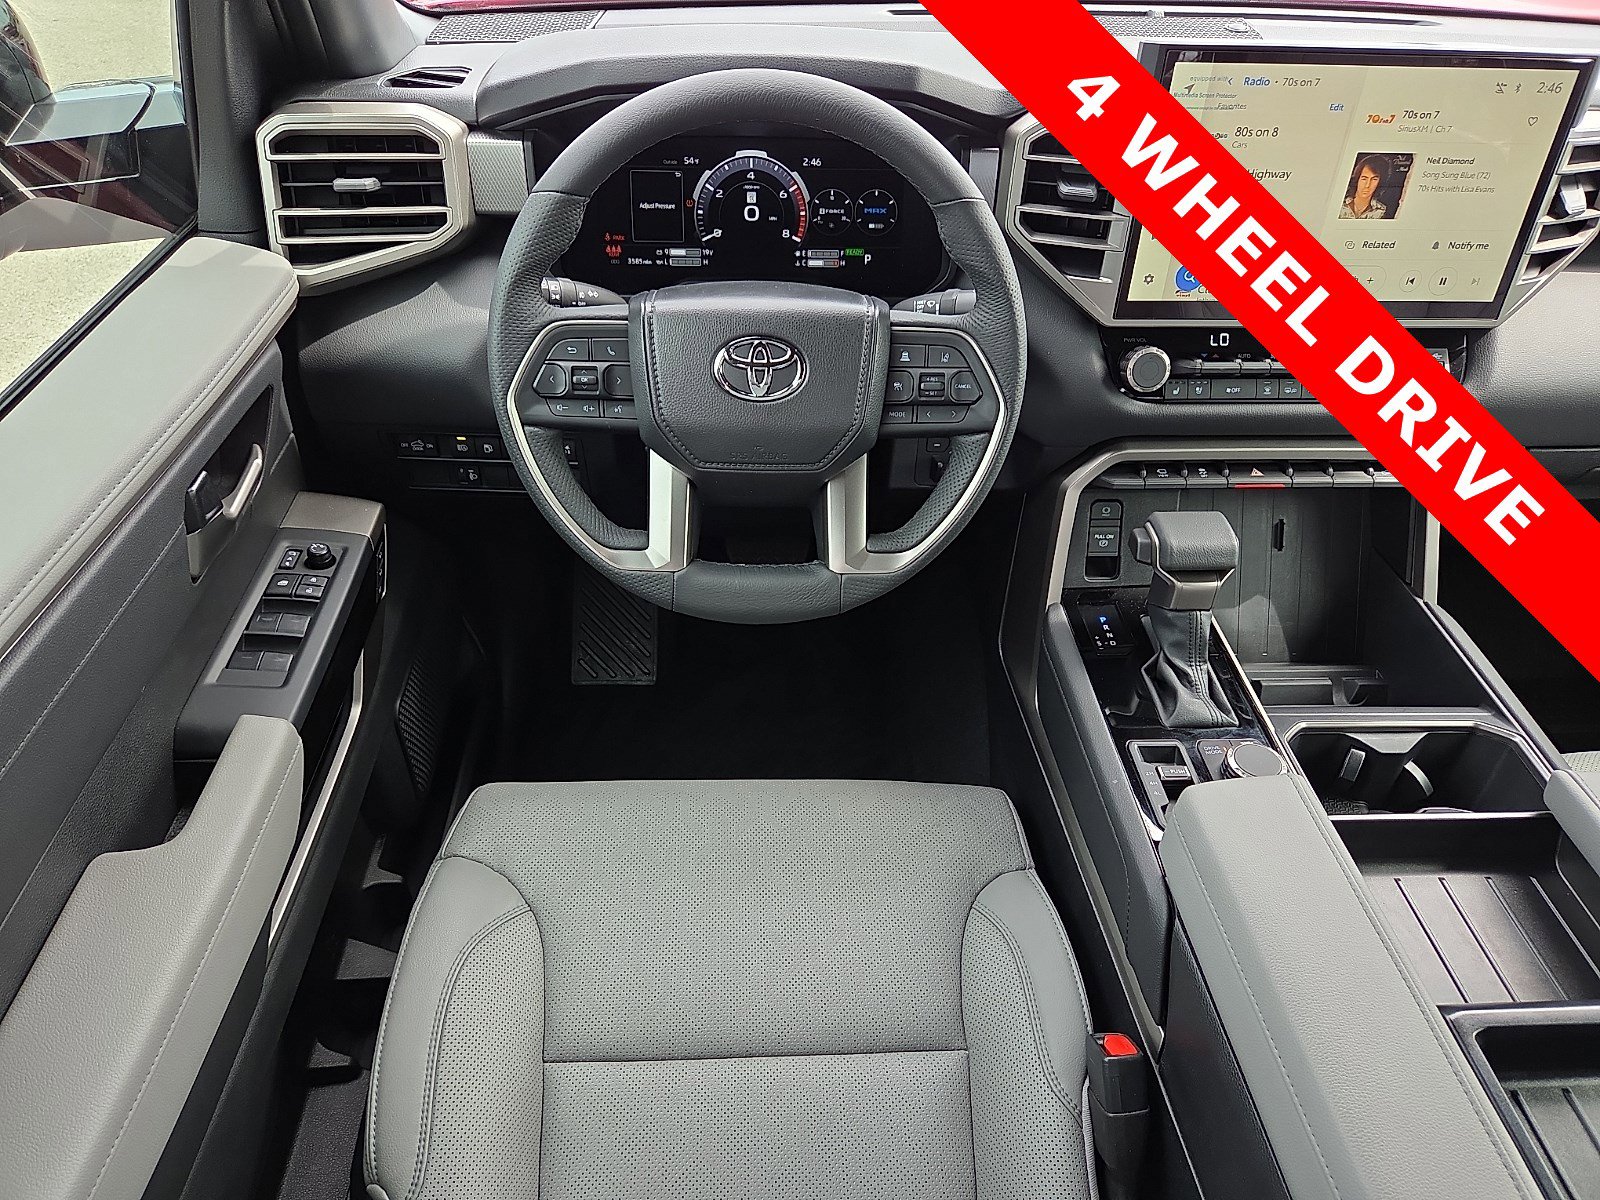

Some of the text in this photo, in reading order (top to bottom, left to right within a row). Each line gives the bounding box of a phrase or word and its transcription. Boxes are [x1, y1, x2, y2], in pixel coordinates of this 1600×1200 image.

[1243, 77, 1270, 87] Radio
[1282, 78, 1299, 87] 70s
[1313, 78, 1321, 87] 7
[1536, 81, 1563, 94] 2:46
[1217, 102, 1248, 110] Favorites
[1329, 103, 1344, 112] Edit
[1402, 110, 1418, 119] 70s
[1433, 110, 1441, 120] 7
[1234, 126, 1253, 138] 80s
[1255, 128, 1270, 138] on
[1271, 126, 1279, 138] 8
[1397, 125, 1429, 133] SiriusXM
[1435, 125, 1446, 133] Ch
[1231, 140, 1248, 149] Cars
[802, 157, 822, 167] 2:46
[1426, 156, 1475, 165] Neil Diamond
[746, 171, 755, 180] 4
[1422, 170, 1491, 180] Song Sung Blue (72)
[1418, 184, 1430, 192] 70s
[1430, 184, 1445, 192] Hits
[1445, 185, 1460, 193] with
[1460, 185, 1475, 193] Lisa
[715, 189, 724, 198] 2
[779, 190, 788, 199] 6
[639, 202, 655, 211] Adjust
[743, 205, 760, 222] 0
[782, 229, 790, 238] 8
[1361, 240, 1396, 249] Related
[1447, 241, 1474, 251] Notify
[801, 259, 807, 267] C
[864, 254, 872, 265] P
[1230, 386, 1242, 394] OFF
